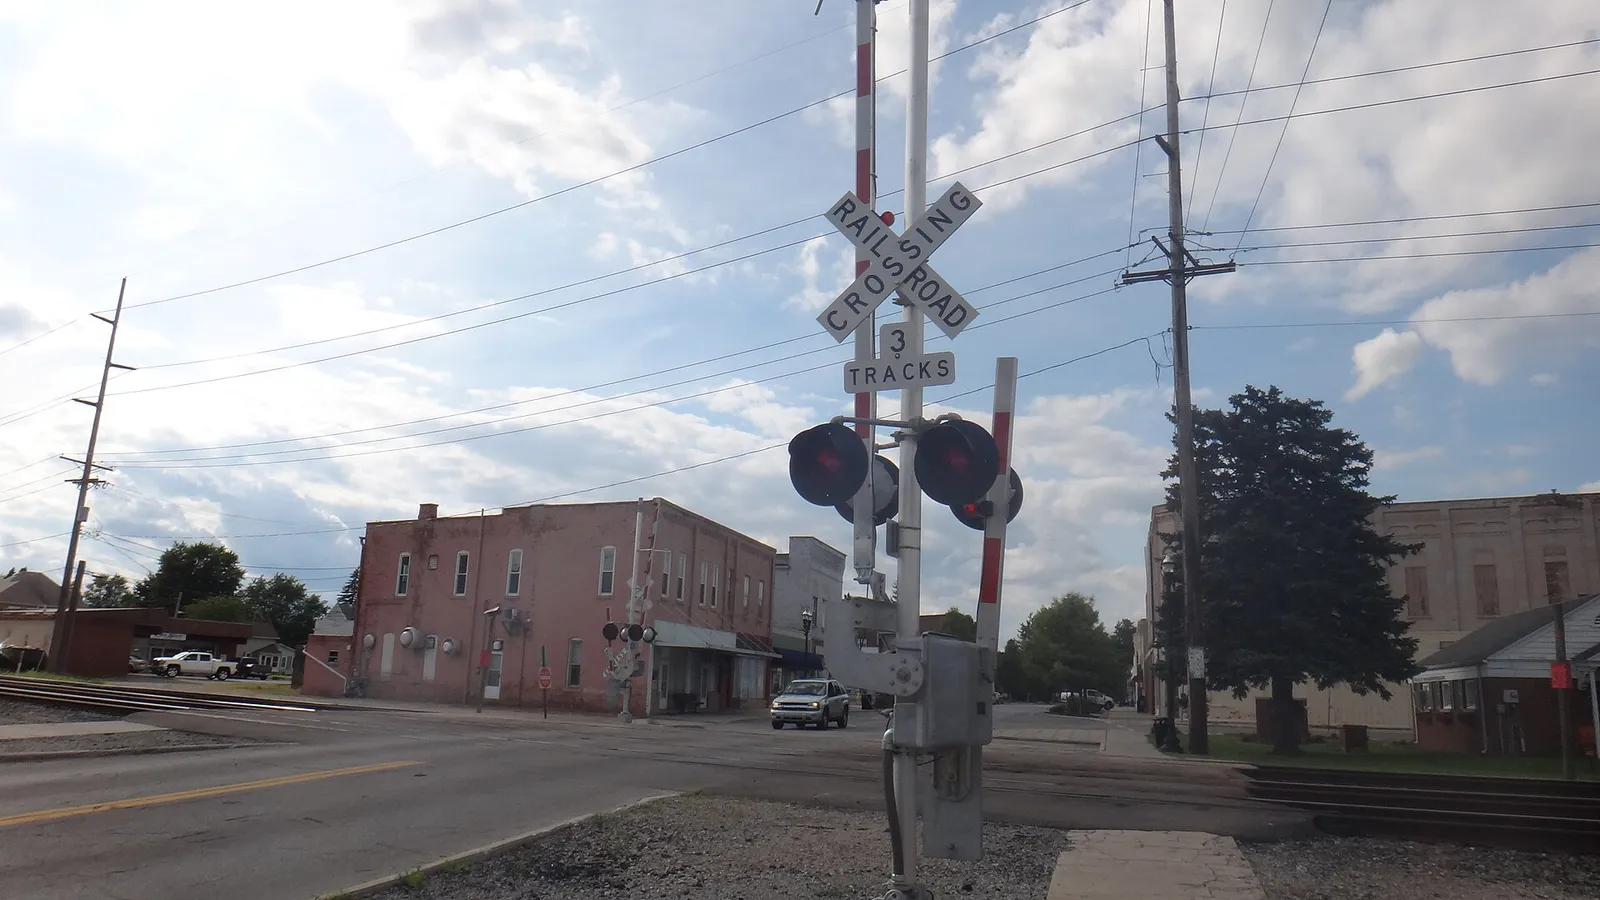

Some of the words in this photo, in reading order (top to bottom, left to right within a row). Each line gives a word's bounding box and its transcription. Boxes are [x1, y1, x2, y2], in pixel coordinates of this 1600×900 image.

[826, 191, 971, 331] CROSSING
[890, 329, 906, 353] 3
[849, 359, 949, 386] TRACKS
